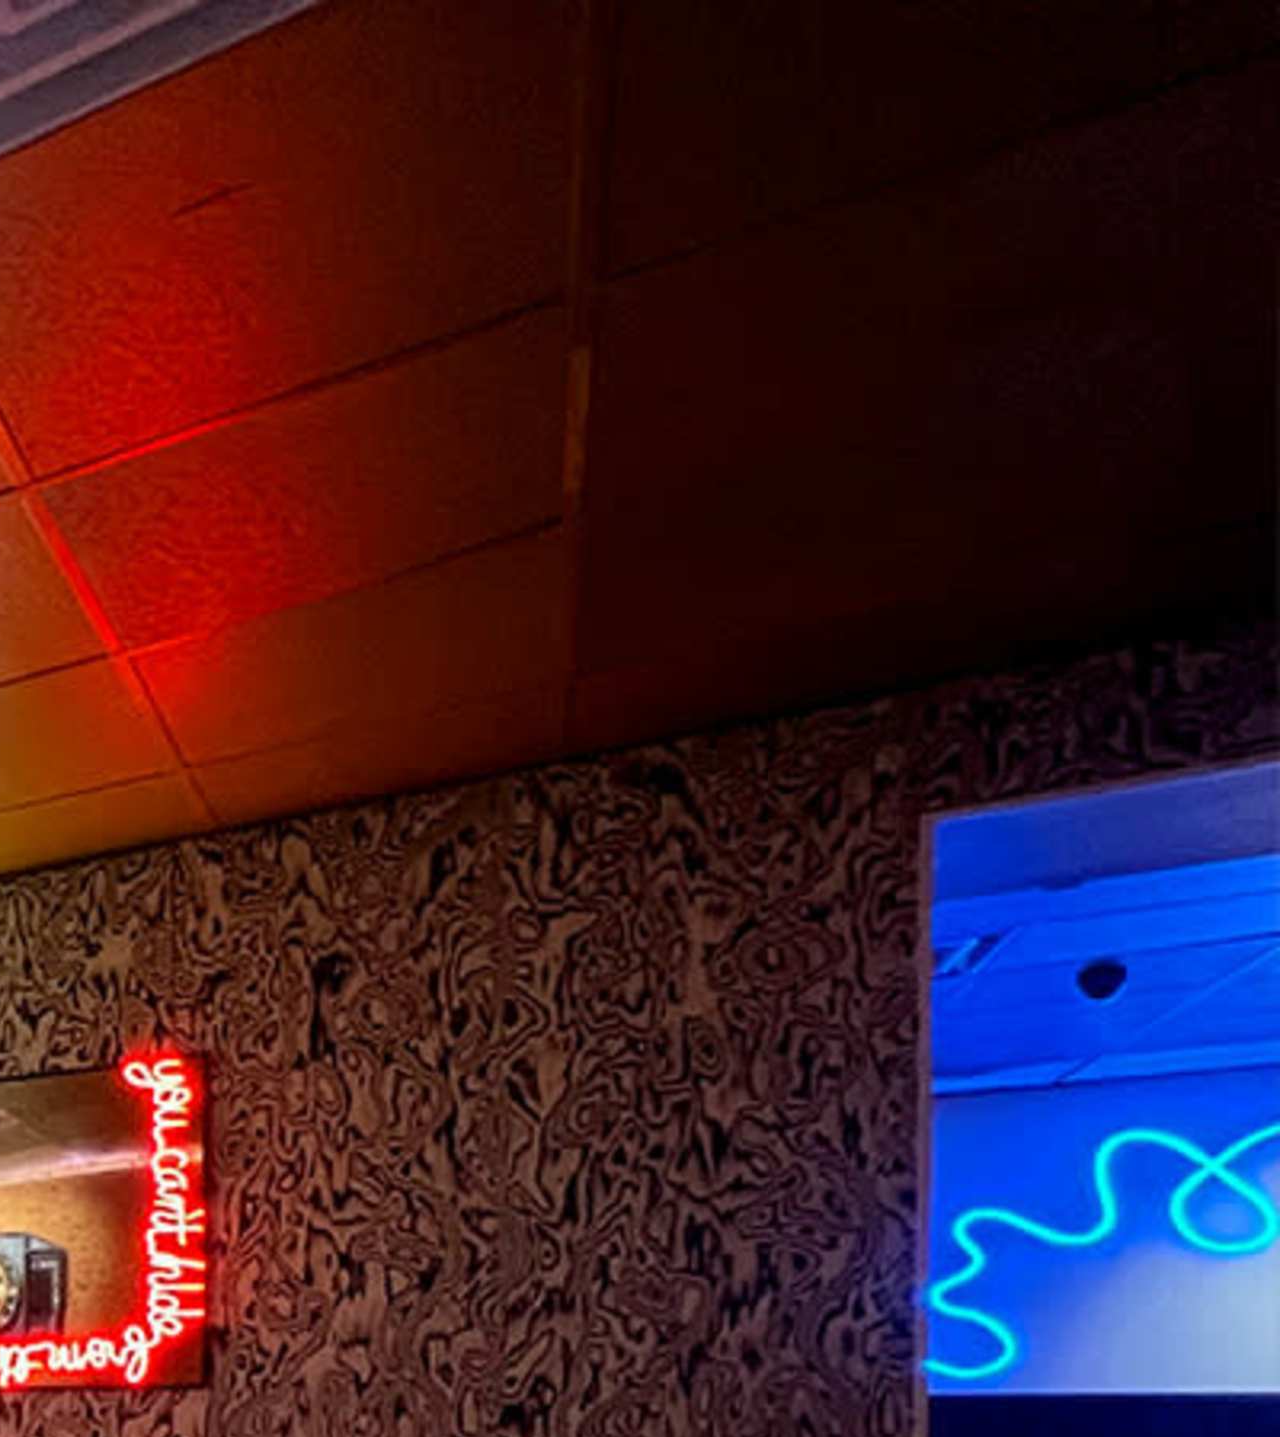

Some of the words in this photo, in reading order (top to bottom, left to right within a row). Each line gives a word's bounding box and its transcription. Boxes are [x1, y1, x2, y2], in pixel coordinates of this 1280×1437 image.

[123, 1058, 191, 1130] you
[146, 1148, 205, 1246] can't
[147, 1253, 206, 1338] hide
[50, 1324, 148, 1384] from
